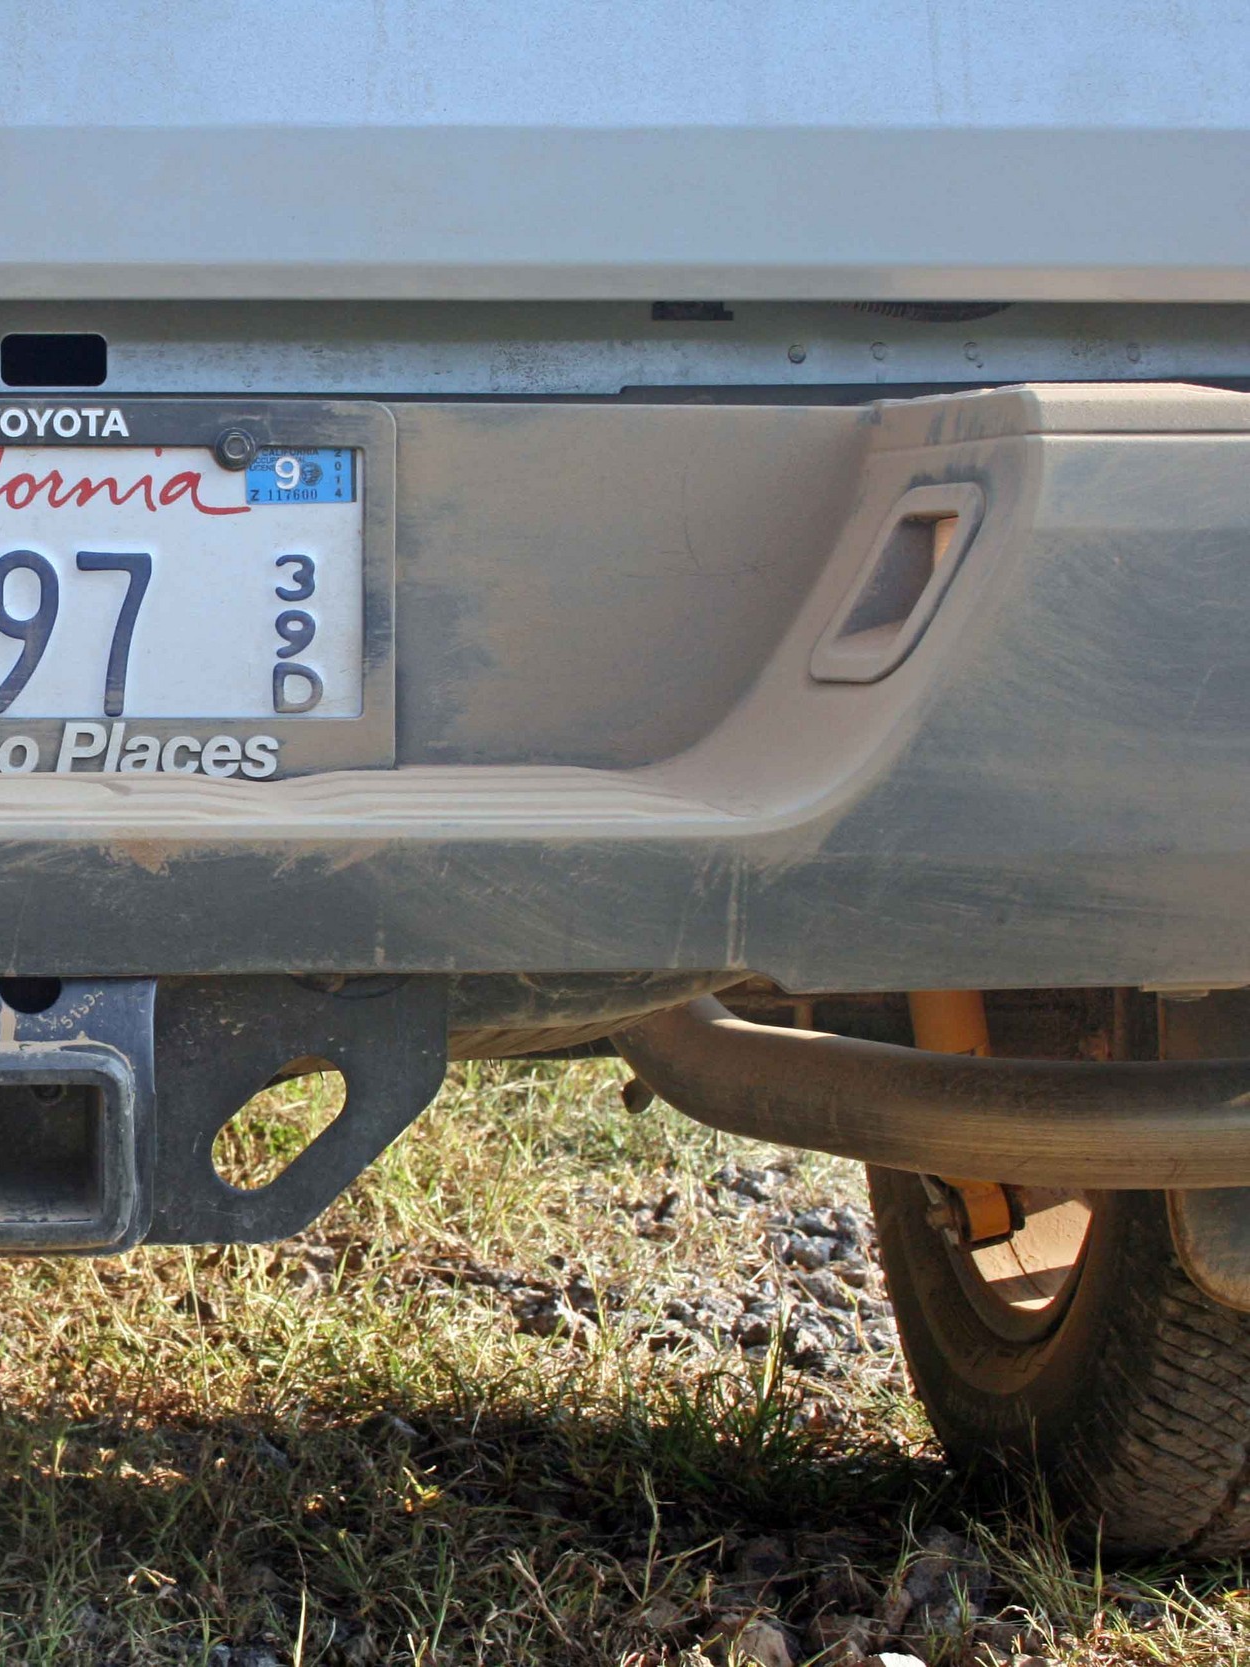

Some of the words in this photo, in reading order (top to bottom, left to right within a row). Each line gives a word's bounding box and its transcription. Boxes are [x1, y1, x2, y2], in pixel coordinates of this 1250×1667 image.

[250, 489, 259, 501] Z
[275, 456, 300, 490] 9
[273, 554, 324, 713] 39D
[57, 721, 279, 779] Places
